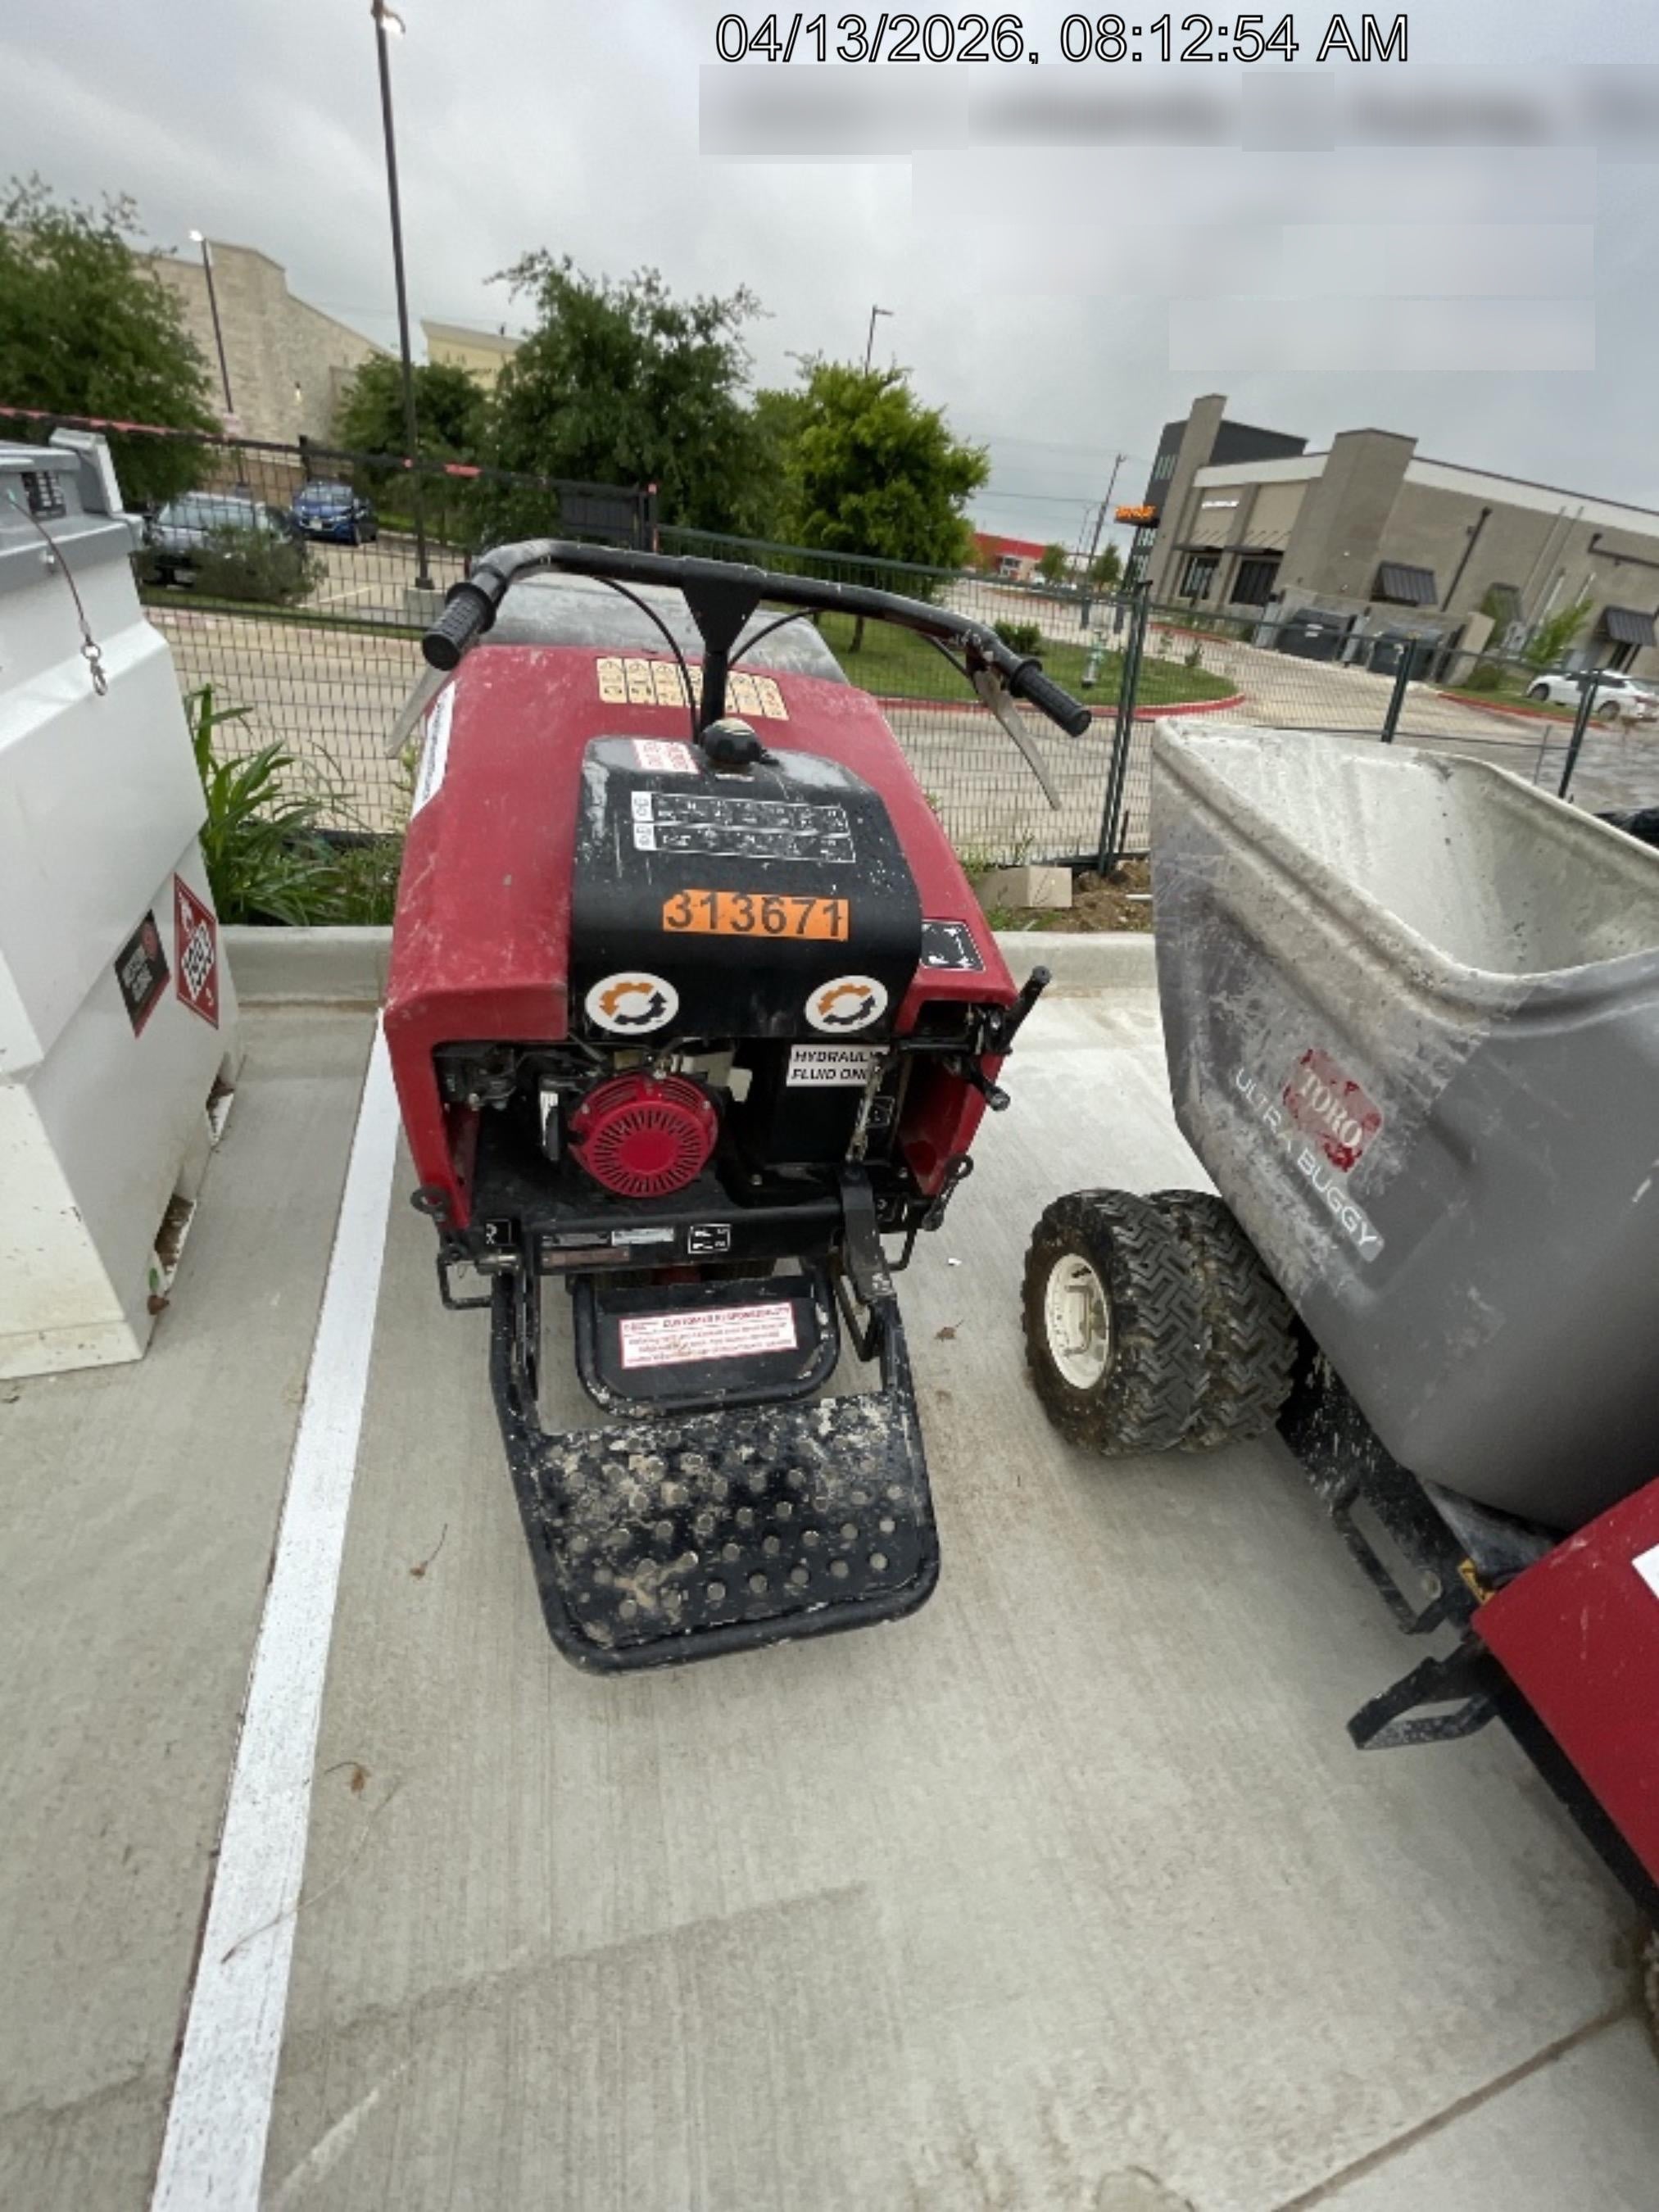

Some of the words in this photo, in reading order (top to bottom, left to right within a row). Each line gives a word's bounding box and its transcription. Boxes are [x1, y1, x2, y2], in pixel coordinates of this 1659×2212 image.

[666, 891, 842, 937] 313671
[791, 1068, 836, 1080] FLUID
[793, 1051, 885, 1063] HYDRAUL
[1299, 1067, 1363, 1148] TORO
[1297, 1148, 1378, 1245] BUGGY
